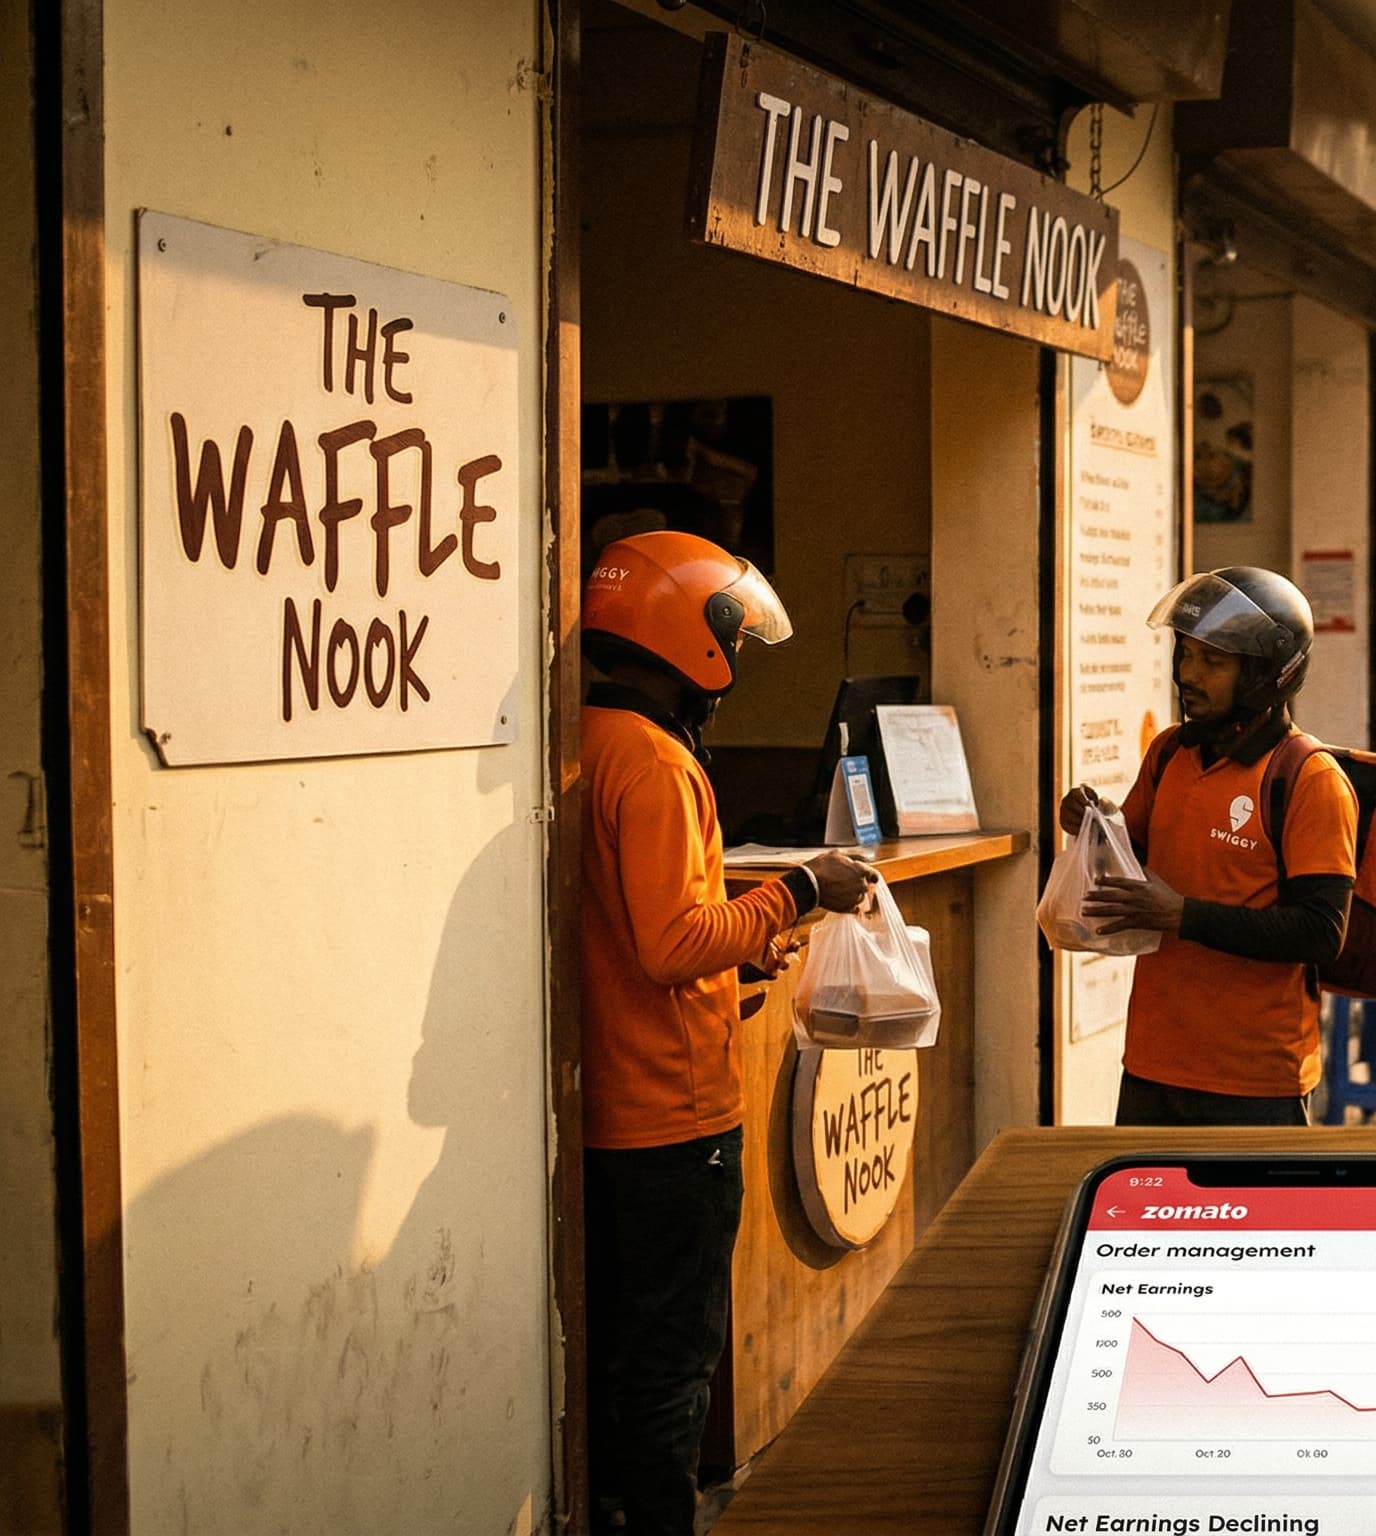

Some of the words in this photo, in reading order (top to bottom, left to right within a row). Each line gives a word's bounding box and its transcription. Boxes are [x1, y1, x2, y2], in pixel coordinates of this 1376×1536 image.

[757, 92, 849, 248] THE
[869, 139, 1016, 300] WAFFLE
[1022, 206, 1106, 330] NOOK
[302, 293, 414, 404] THE
[170, 412, 503, 597] WAFFLE
[282, 597, 430, 721] NOOK
[1210, 828, 1258, 850] SWIGGY
[823, 1072, 911, 1159] WAFFLE
[845, 1143, 895, 1214] NOOK
[1129, 1176, 1163, 1187] 9:22
[1140, 1202, 1248, 1221] zomato
[1096, 1243, 1161, 1258] Order
[1165, 1243, 1316, 1261] management
[1101, 1283, 1133, 1295] Net
[1137, 1283, 1214, 1297] Earnings
[1091, 1369, 1112, 1378] 500
[1087, 1435, 1101, 1445] 50
[1195, 1449, 1214, 1458] Oct
[1217, 1449, 1231, 1458] 20
[1045, 1514, 1088, 1532] Net
[1094, 1514, 1200, 1536] Earnings
[1208, 1514, 1319, 1536] Declining
